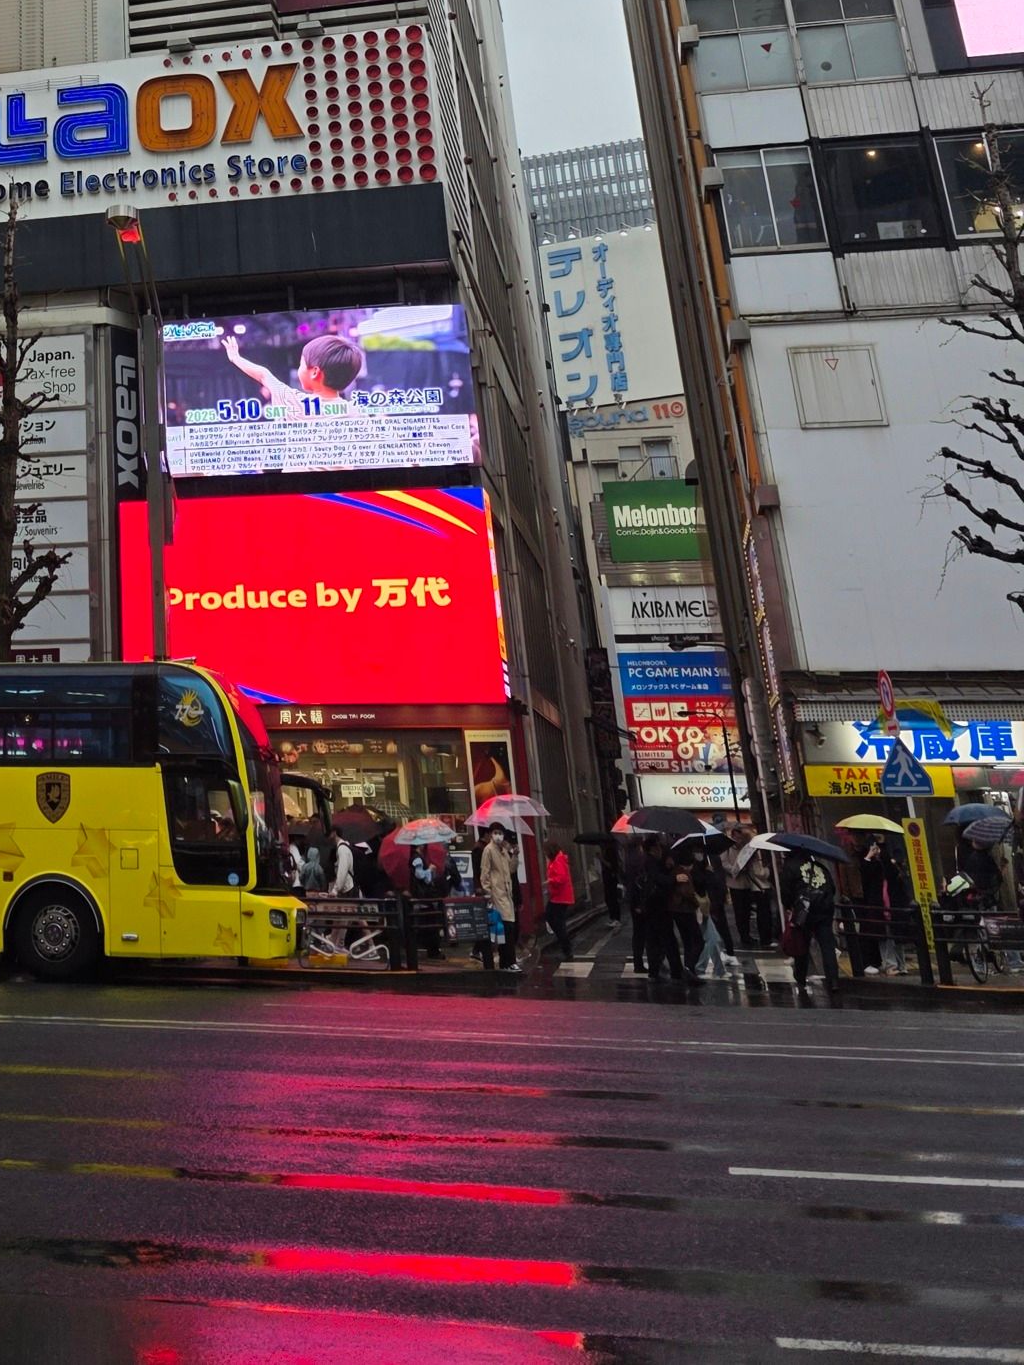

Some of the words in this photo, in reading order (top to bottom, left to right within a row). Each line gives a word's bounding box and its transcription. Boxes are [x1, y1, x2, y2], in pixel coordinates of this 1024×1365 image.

[60, 160, 216, 195] Electronics
[227, 150, 308, 182] Store
[547, 246, 598, 402] テレオン
[592, 242, 628, 393] オーディオ専門店
[28, 349, 75, 364] Japan.
[24, 365, 76, 381] Tax-free
[42, 381, 76, 396] Shop
[352, 389, 443, 407] 海の森公園
[218, 398, 260, 421] 5.10
[265, 405, 287, 418] SAT
[301, 397, 321, 416] 11
[324, 403, 348, 415] SUN
[24, 525, 58, 537] Souvenirs
[168, 584, 307, 610] Produce
[316, 582, 362, 613] by
[372, 577, 451, 607] 万代
[631, 600, 673, 619] AKIBA
[629, 667, 643, 678] PC
[645, 667, 679, 678] GAME
[681, 667, 712, 677] MAIN
[279, 710, 323, 725] 周大福
[628, 726, 703, 744] TOKYO
[638, 751, 666, 759] LIMITED
[833, 767, 869, 780] TAX
